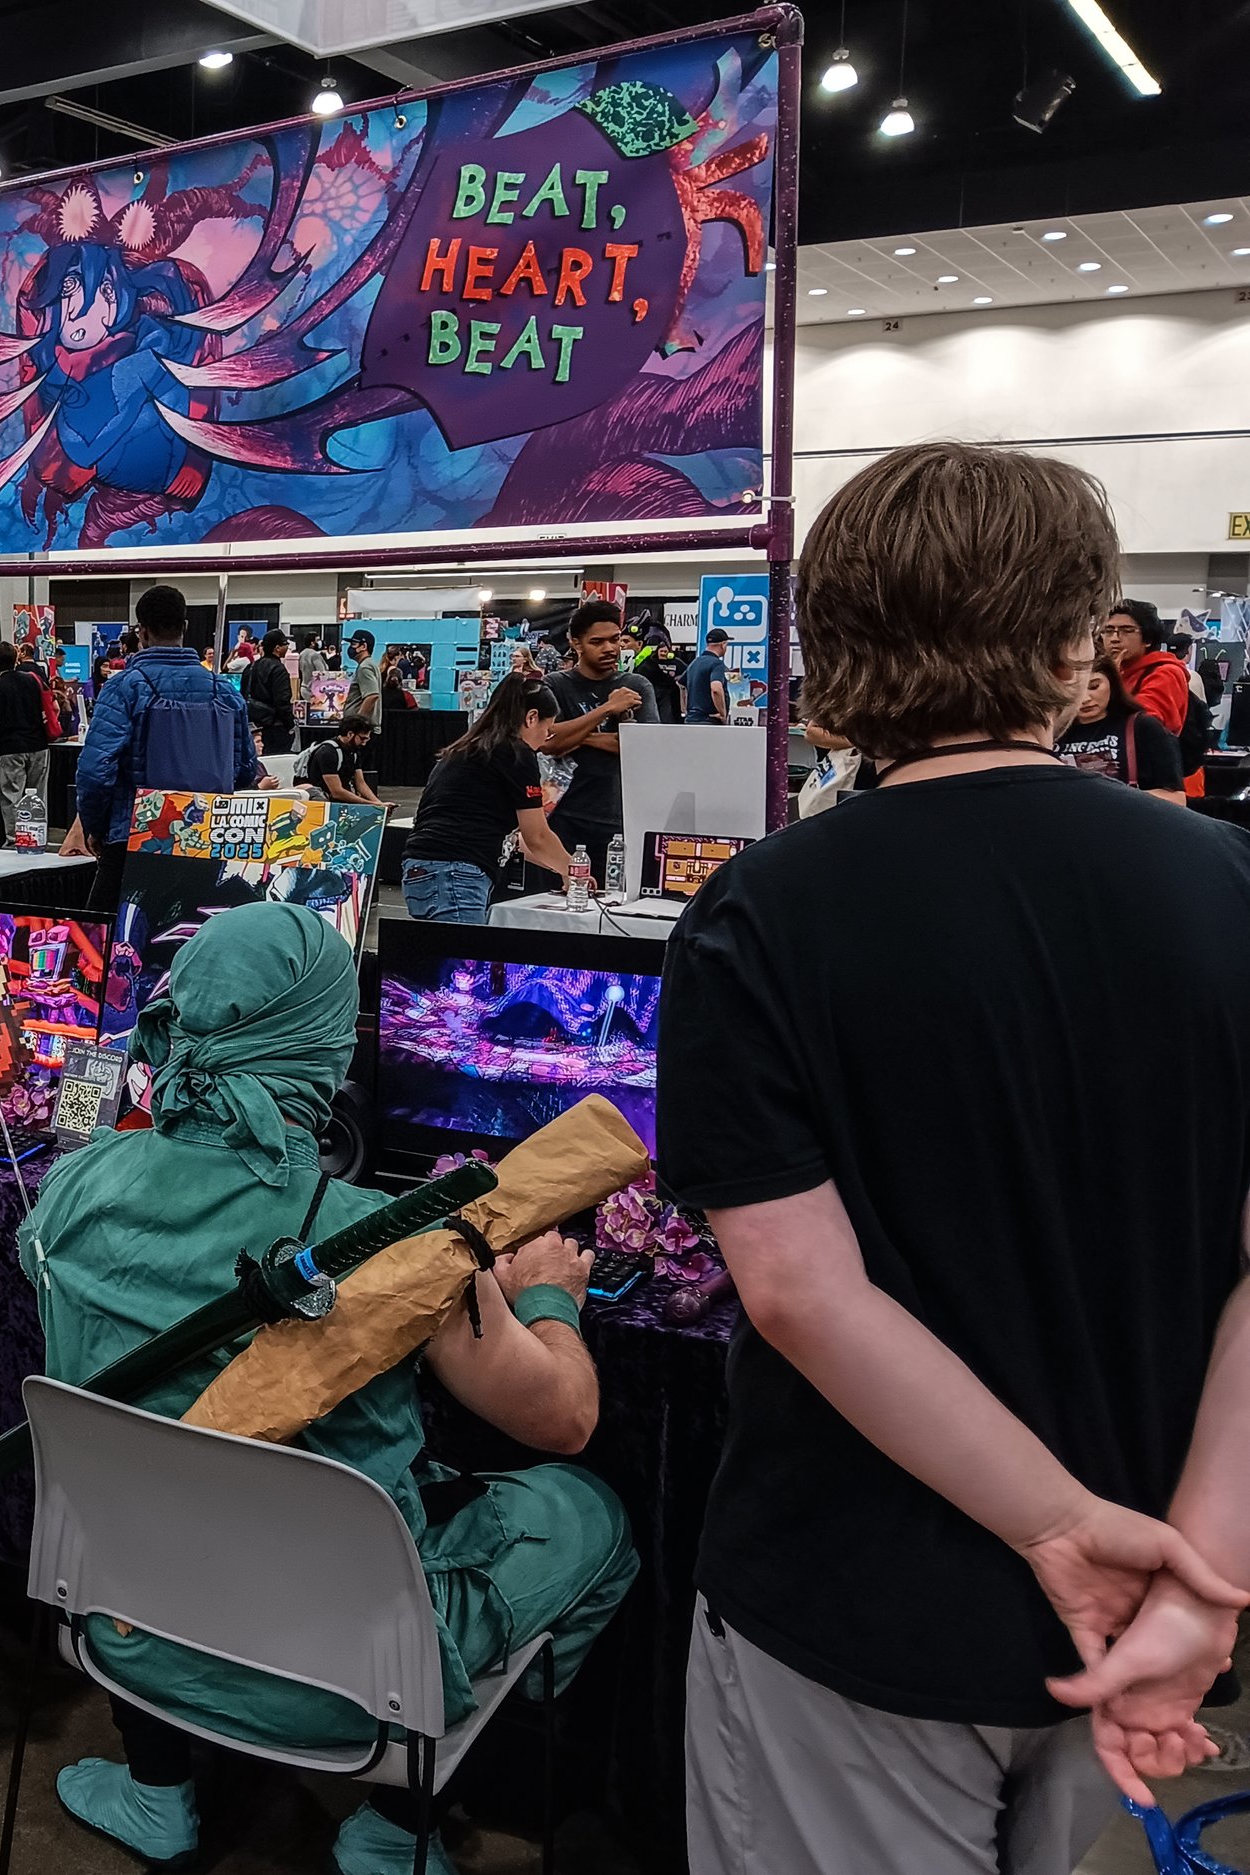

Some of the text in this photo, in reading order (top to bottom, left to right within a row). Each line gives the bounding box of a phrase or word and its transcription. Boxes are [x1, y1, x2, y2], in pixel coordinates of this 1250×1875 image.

[452, 162, 626, 230] BEAT,
[420, 237, 649, 322] HEART,
[884, 320, 899, 331] 24
[427, 309, 584, 382] BEAT
[230, 815, 267, 828] COMIC
[210, 828, 265, 844] CON
[210, 843, 263, 858] 2025
[71, 1046, 124, 1063] JOIN THE DISCORD
